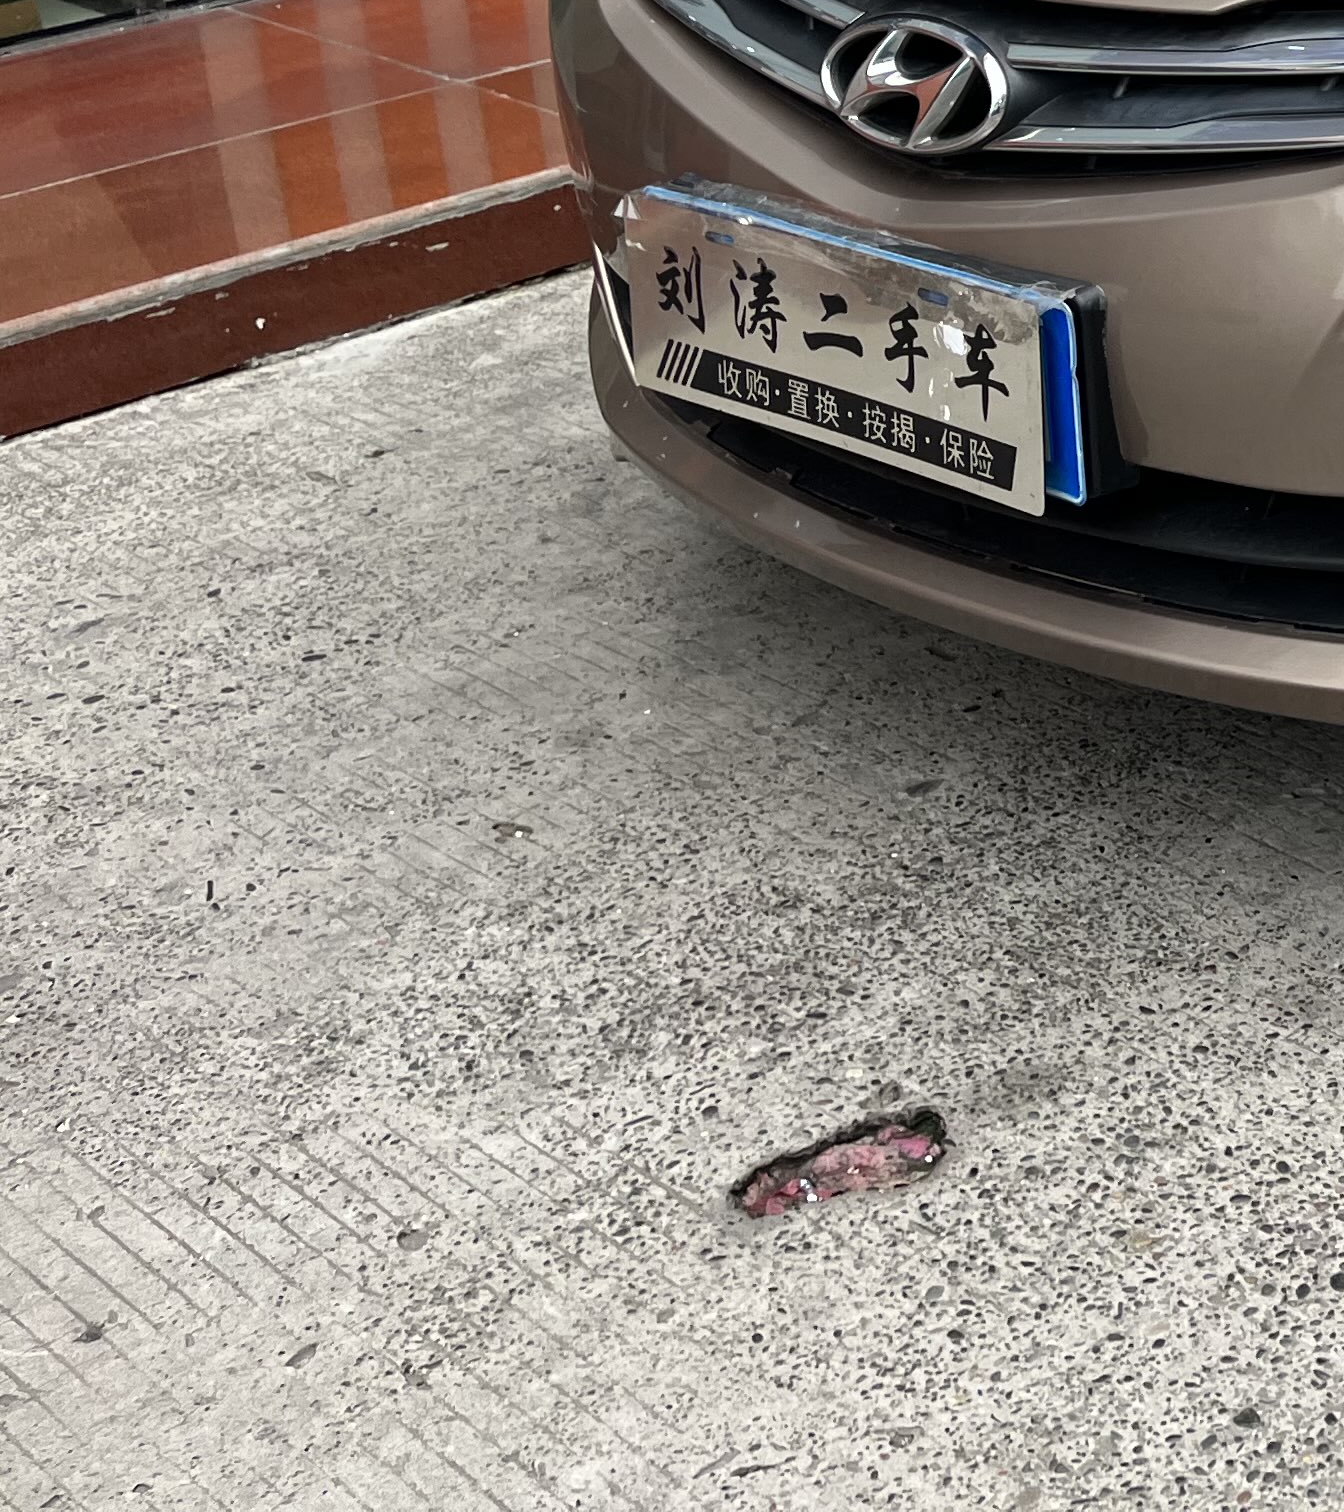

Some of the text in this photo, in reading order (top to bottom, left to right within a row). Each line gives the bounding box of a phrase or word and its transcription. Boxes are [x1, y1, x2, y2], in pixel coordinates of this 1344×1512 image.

[654, 244, 1012, 423] 刘涛二手车
